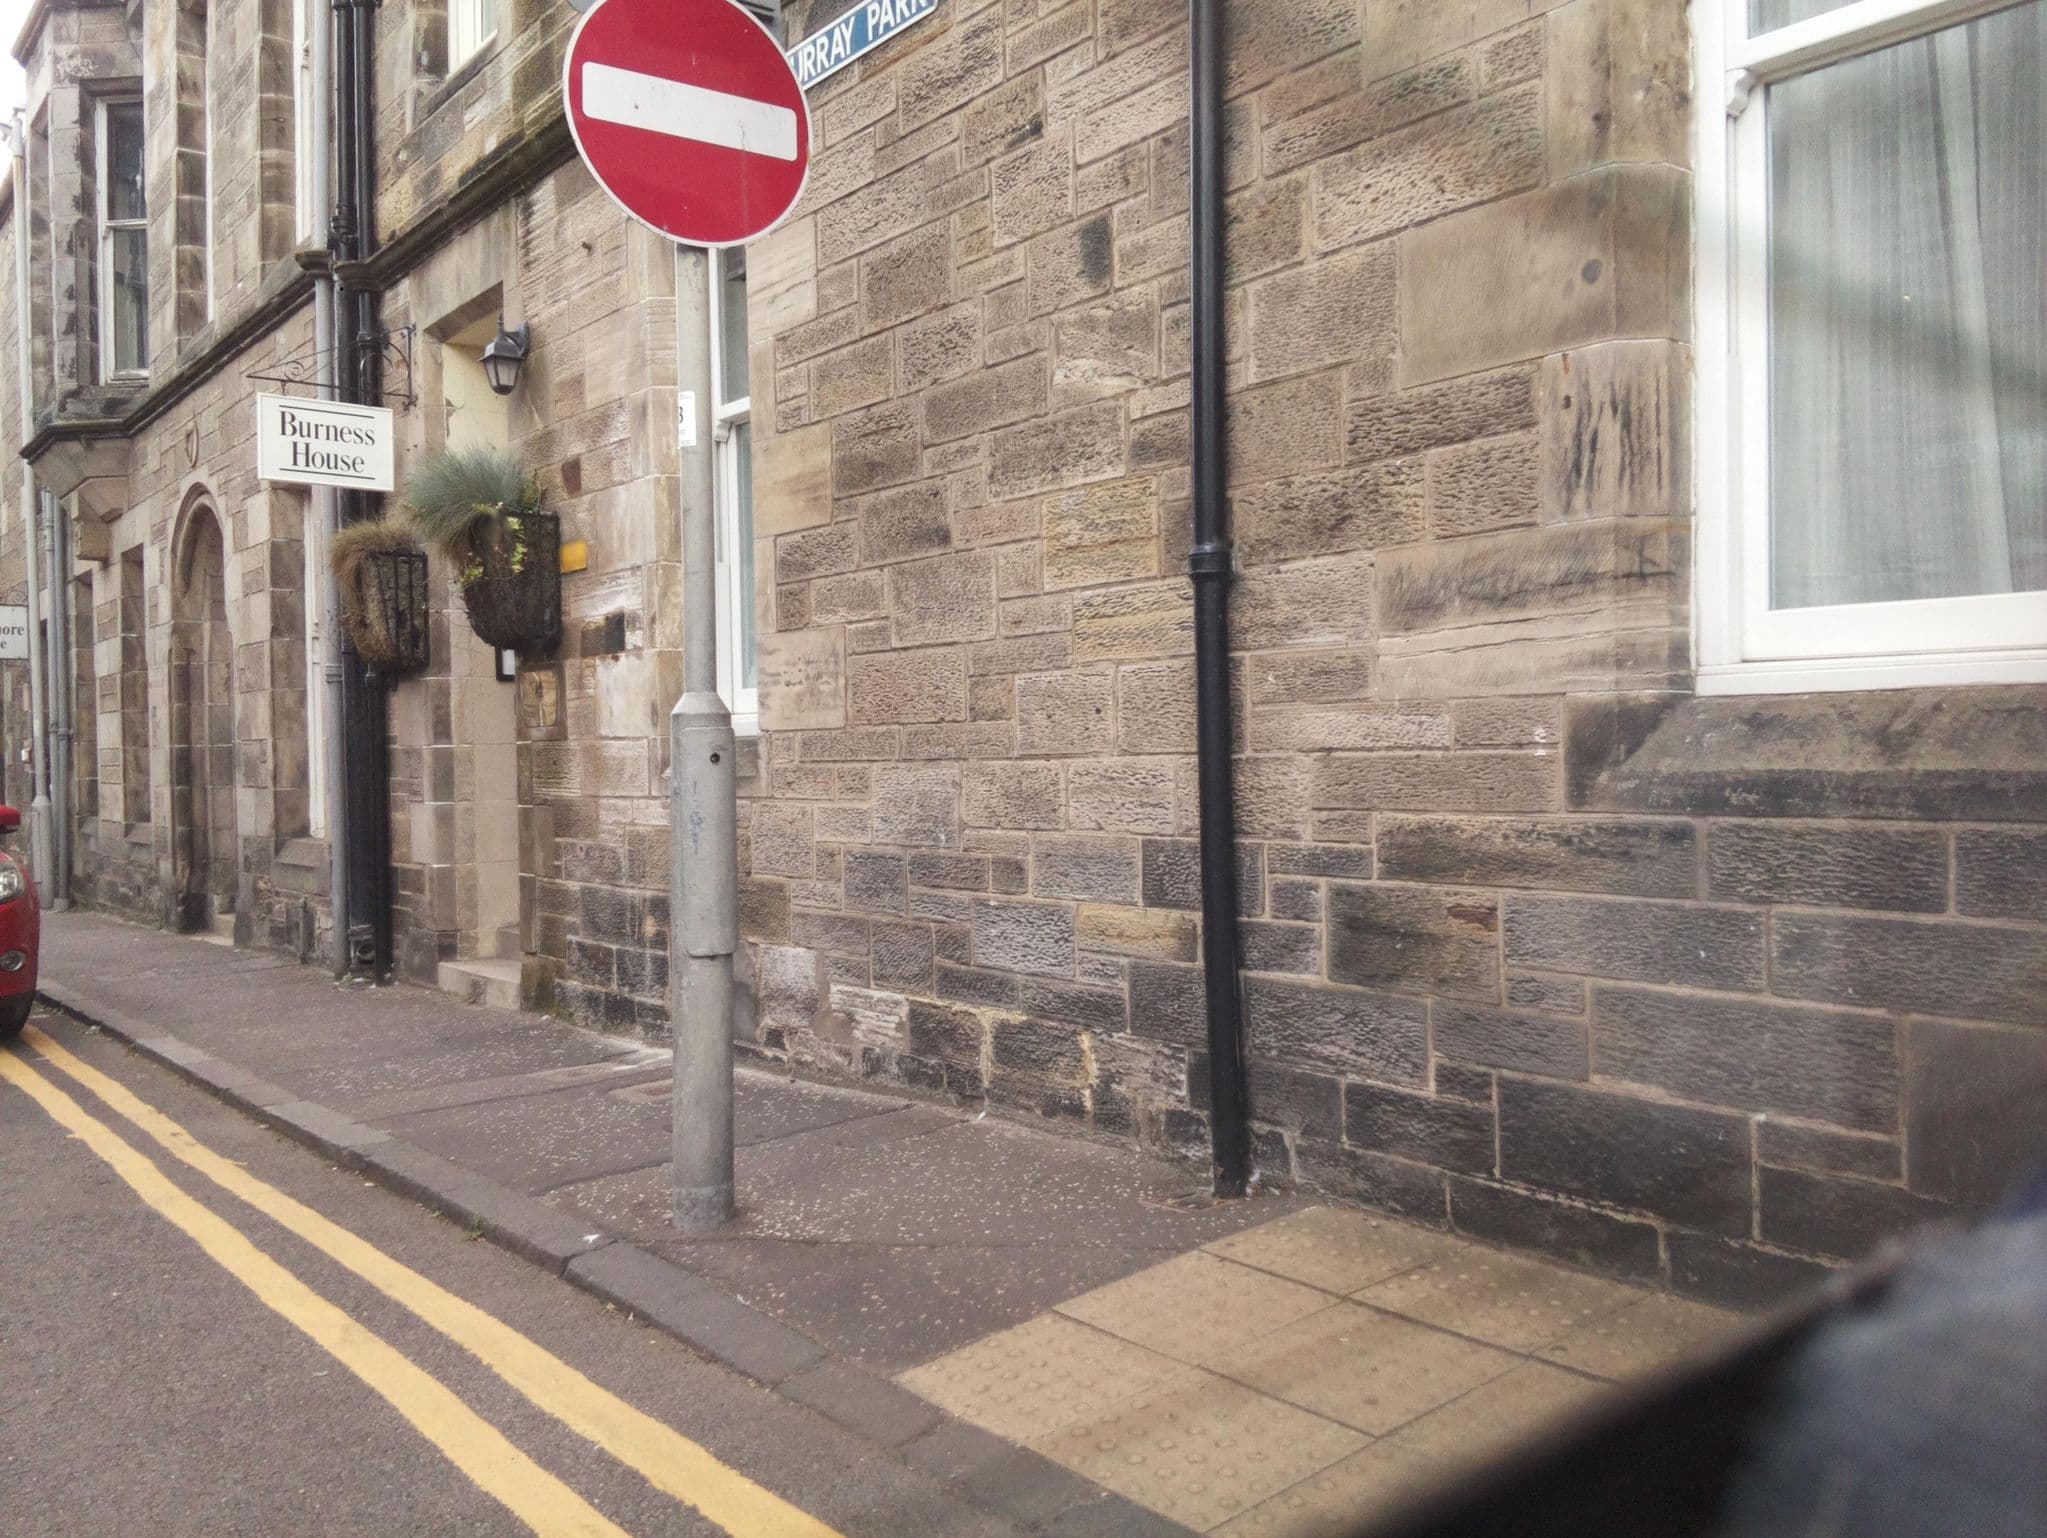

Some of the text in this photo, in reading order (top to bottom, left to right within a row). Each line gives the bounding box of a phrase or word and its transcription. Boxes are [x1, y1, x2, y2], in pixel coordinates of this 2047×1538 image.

[790, 15, 856, 82] URRAY
[280, 411, 376, 446] Burness
[291, 441, 365, 473] House
[0, 624, 25, 636] ore
